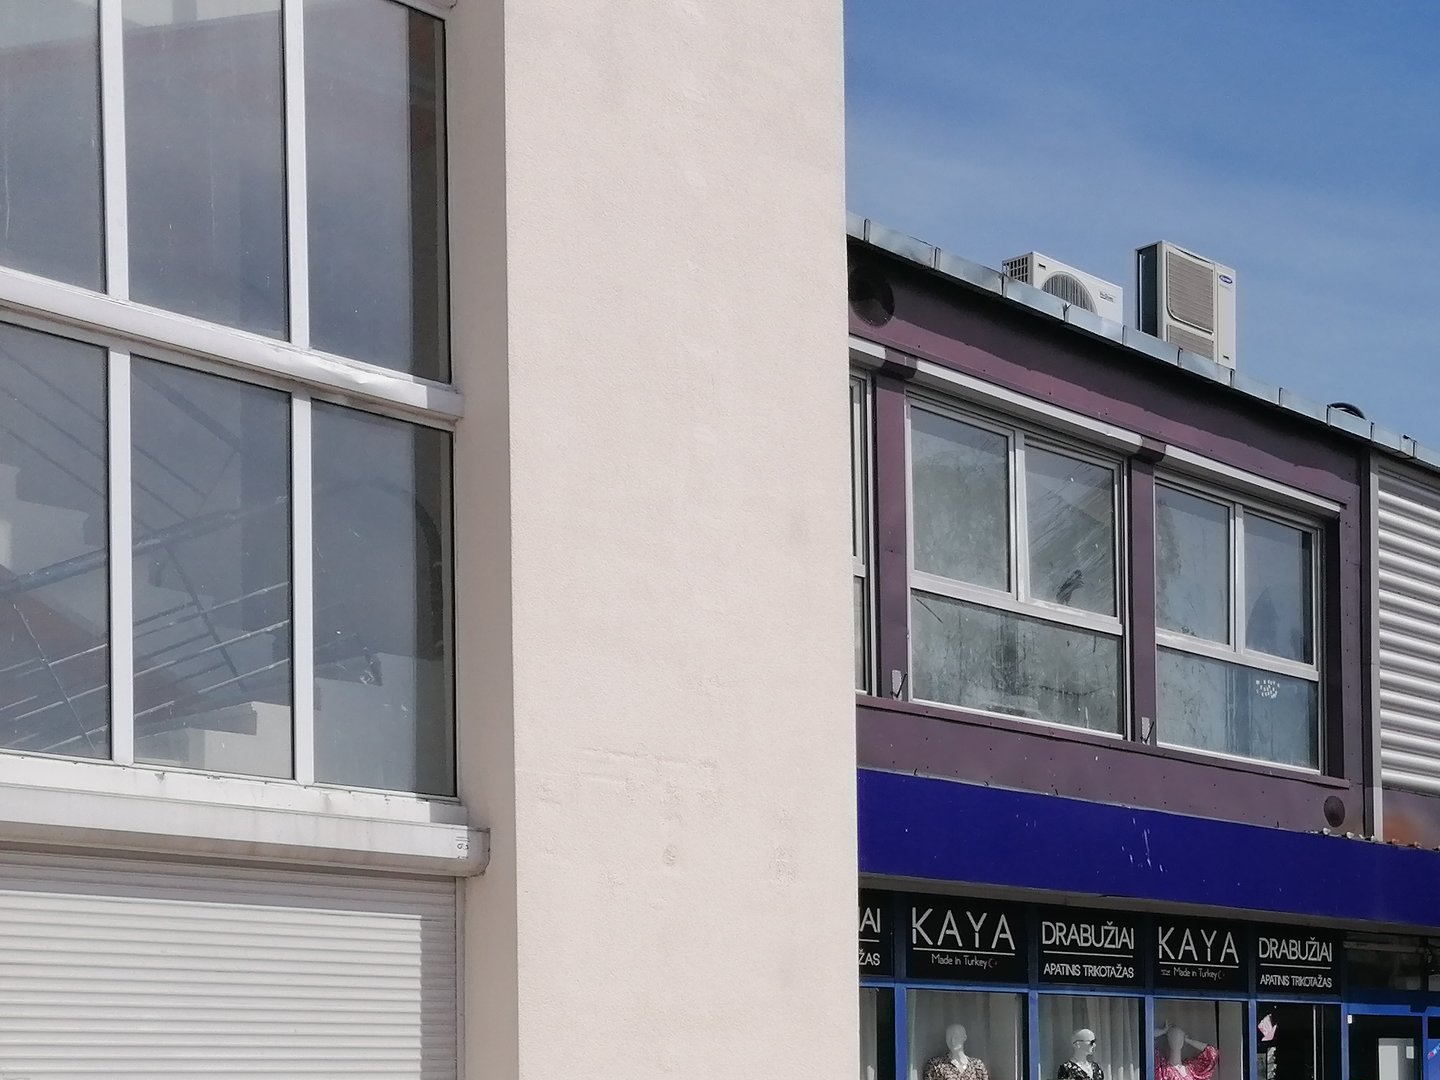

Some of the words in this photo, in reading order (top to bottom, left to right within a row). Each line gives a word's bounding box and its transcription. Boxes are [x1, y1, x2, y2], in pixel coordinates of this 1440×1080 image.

[858, 907, 881, 933] AI
[911, 907, 1016, 950] KAYA
[1042, 920, 1134, 950] DRABUŽIAI
[1158, 926, 1239, 963] KAYA
[931, 953, 953, 965] Made
[963, 955, 987, 969] Turkey
[1258, 937, 1332, 962] DRABUŽIAI
[1173, 967, 1191, 977] Made
[1199, 968, 1218, 981] Turkey
